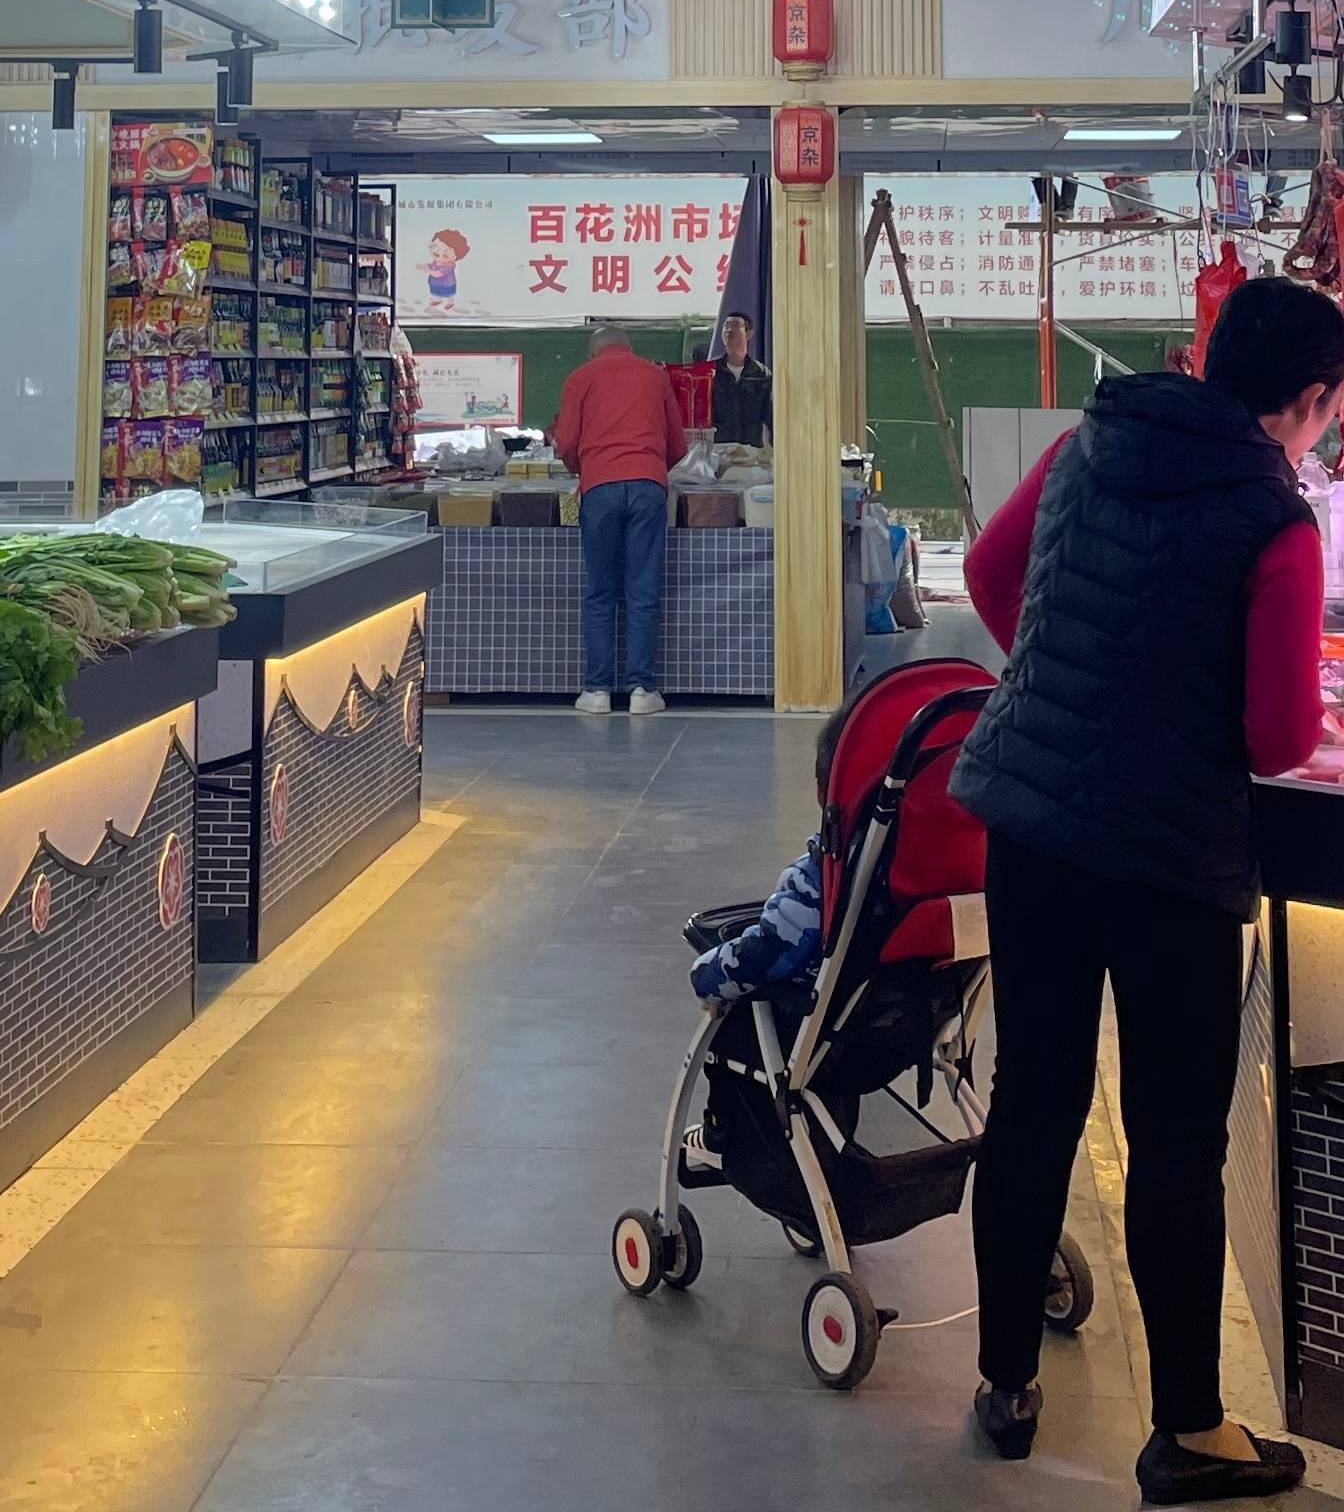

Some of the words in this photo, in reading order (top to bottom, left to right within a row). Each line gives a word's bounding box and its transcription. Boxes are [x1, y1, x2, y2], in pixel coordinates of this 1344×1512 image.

[527, 202, 742, 245] 百花洲市场
